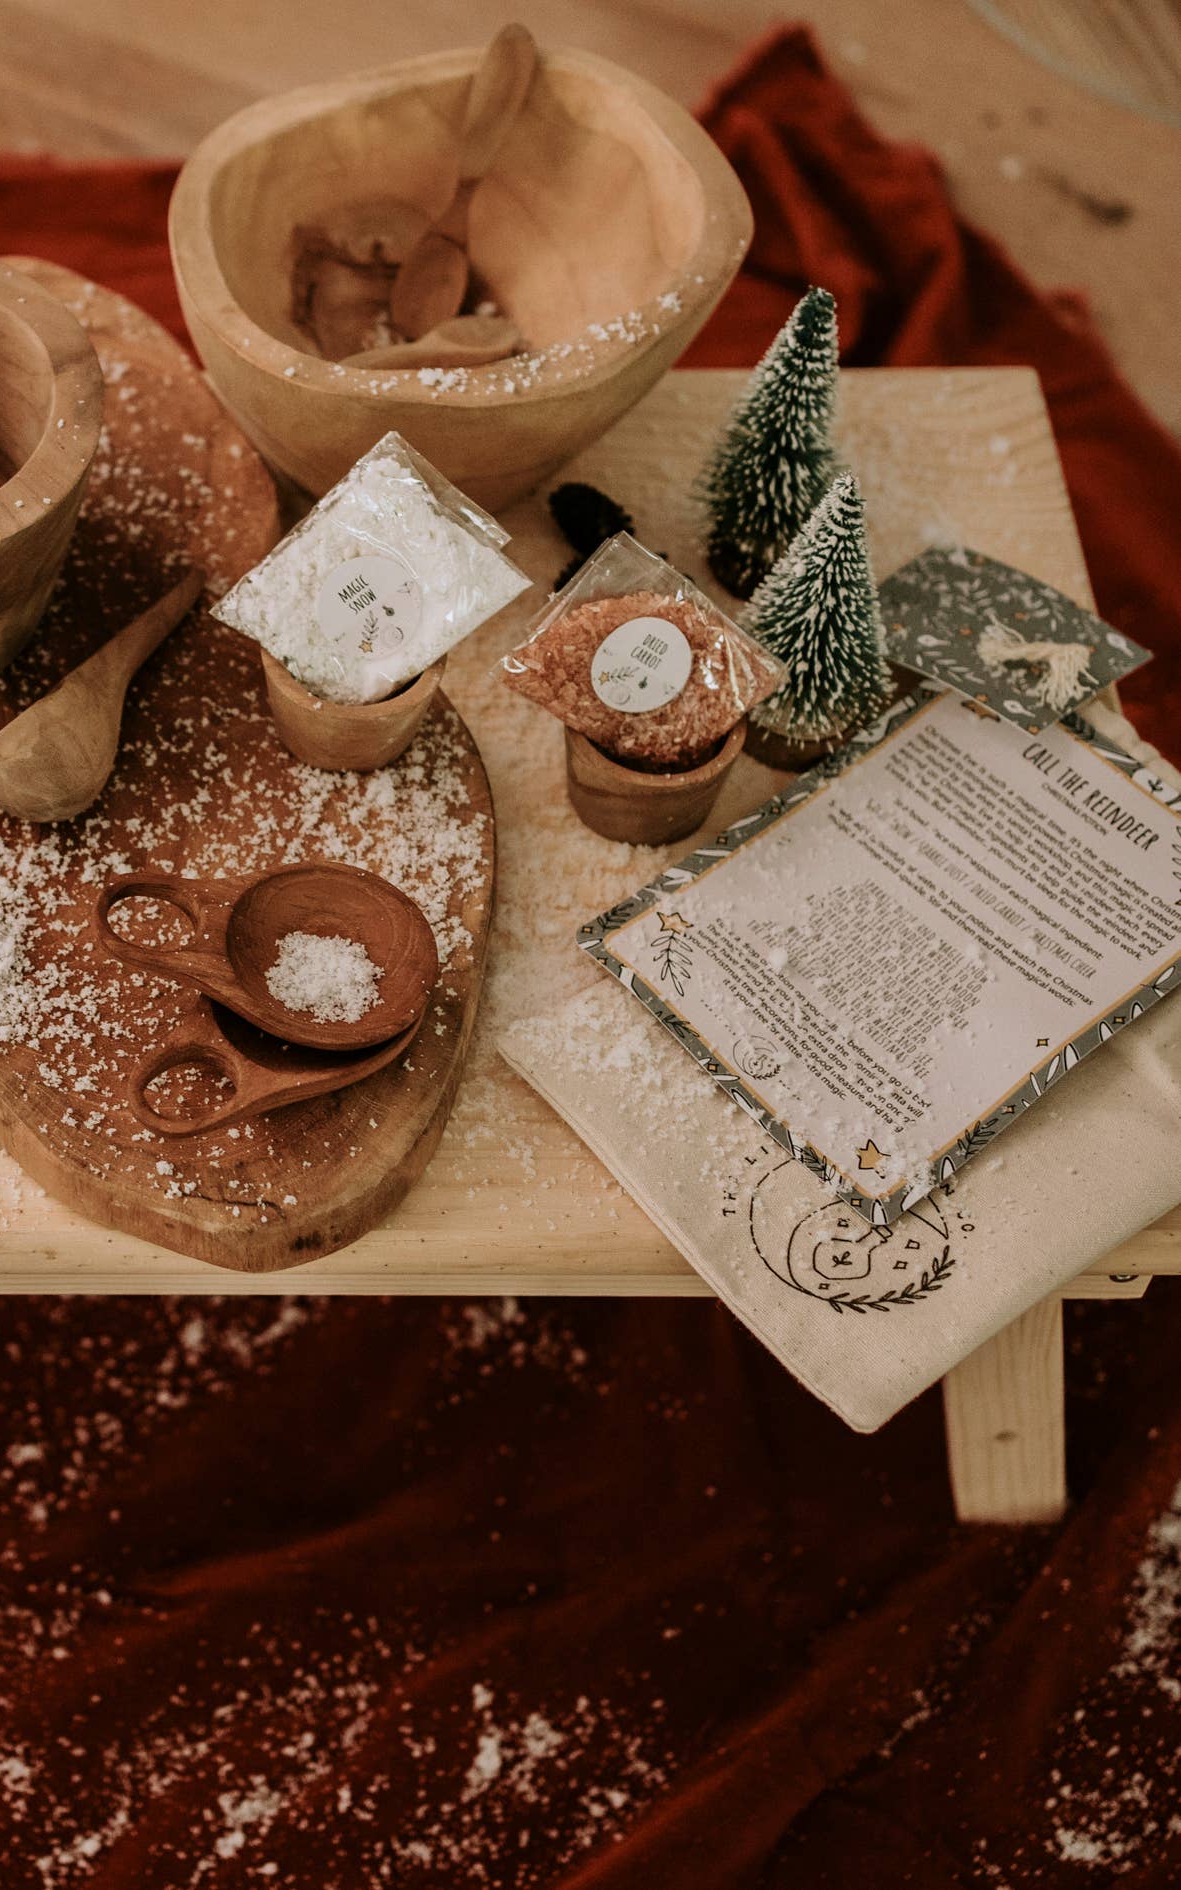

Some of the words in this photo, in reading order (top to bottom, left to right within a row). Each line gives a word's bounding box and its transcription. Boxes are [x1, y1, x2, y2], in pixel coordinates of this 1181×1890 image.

[338, 574, 370, 603] MAGIC
[349, 589, 377, 616] SNOW
[642, 633, 670, 654] DRIED
[630, 646, 663, 670] CARROT
[1018, 741, 1066, 776] CALL
[1051, 767, 1093, 797] THE
[1078, 789, 1164, 851] REINDEER
[926, 896, 942, 908] Stir
[938, 905, 959, 921] and
[955, 918, 978, 936] then
[974, 933, 996, 950] read
[992, 947, 1018, 967] these
[1013, 963, 1049, 992] magical
[1046, 985, 1076, 1009] words:
[937, 889, 951, 900] to
[945, 897, 969, 915] your
[965, 912, 997, 937] potion
[992, 933, 1013, 949] and
[1010, 946, 1038, 968] watch
[1035, 965, 1053, 979] the
[1051, 973, 1095, 1008] Chirstmas
[946, 840, 966, 855] one
[998, 880, 1012, 891] of
[1007, 888, 1030, 906] each
[1025, 902, 1062, 930] magical
[1056, 925, 1105, 962] ingredient:
[687, 934, 707, 951] your
[704, 948, 743, 983] Christmas
[739, 981, 758, 997] tree
[797, 1039, 812, 1052] for
[705, 923, 722, 937] The
[743, 956, 760, 970] will
[755, 968, 777, 987] help
[808, 1020, 828, 1037] and
[825, 1034, 837, 1045] in
[834, 1043, 851, 1058] the
[905, 1103, 923, 1119] will
[728, 984, 737, 992] it
[733, 991, 754, 1009] your
[750, 1007, 770, 1025] tree
[783, 1040, 804, 1058] little
[818, 1075, 848, 1102] magic.
[846, 1039, 874, 1064] before
[886, 1075, 903, 1089] go
